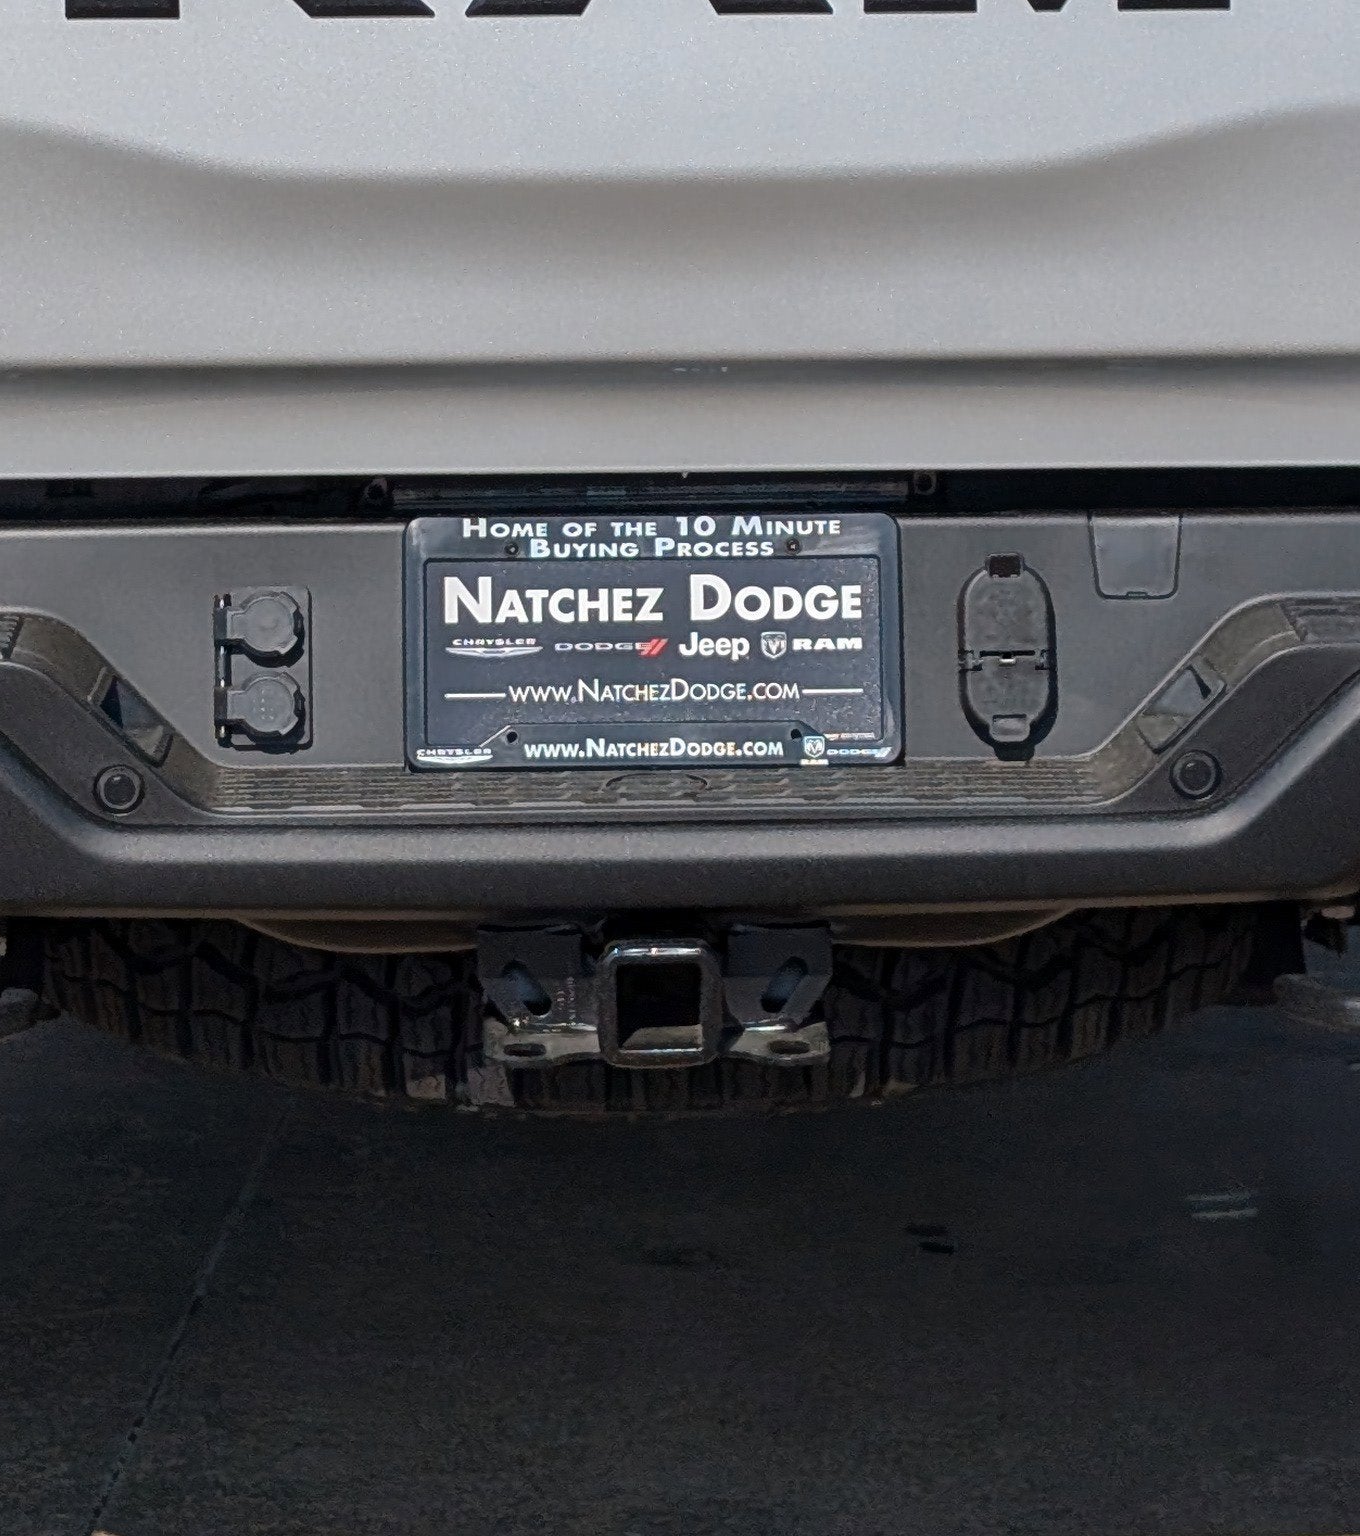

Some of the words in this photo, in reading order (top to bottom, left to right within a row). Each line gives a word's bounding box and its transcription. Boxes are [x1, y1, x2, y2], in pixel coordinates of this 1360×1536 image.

[676, 515, 716, 536] 10
[452, 638, 536, 646] CHRYSLER
[554, 642, 652, 652] DODGE
[679, 631, 750, 661] Jeep
[792, 637, 863, 651] RAM
